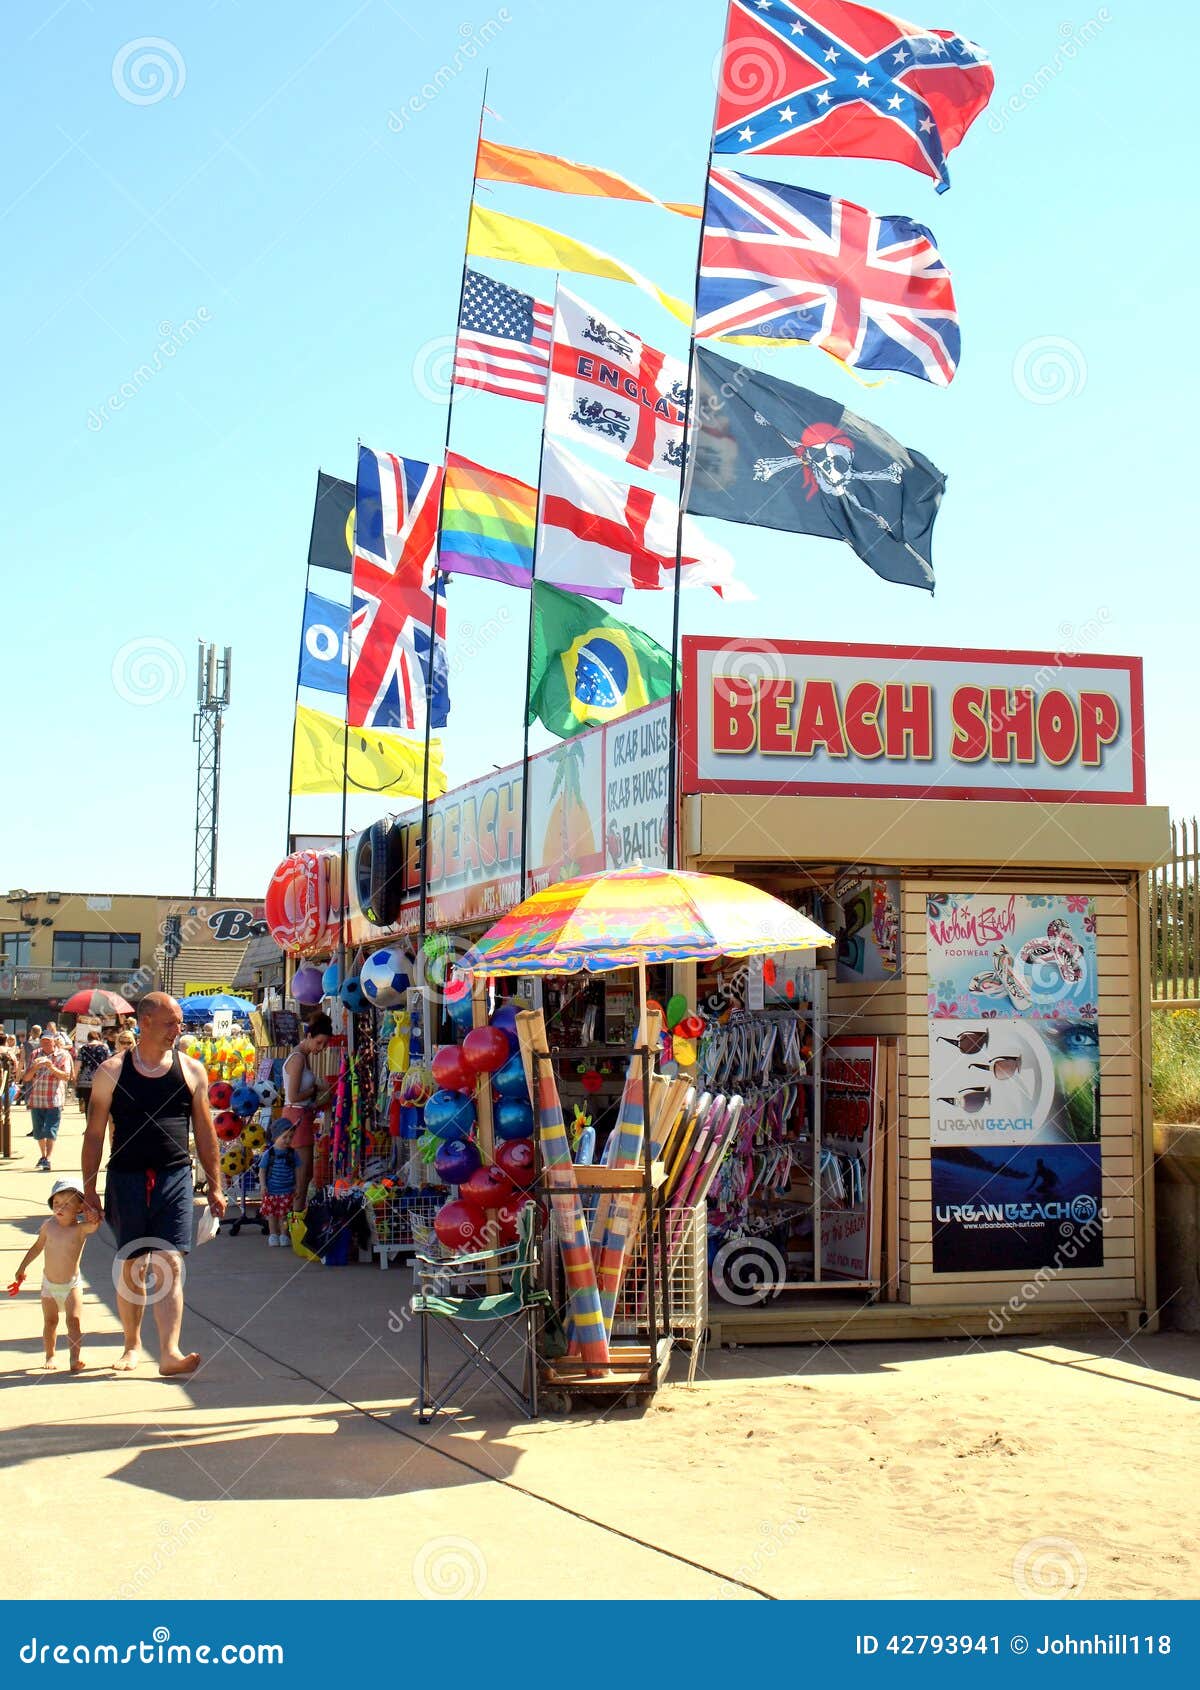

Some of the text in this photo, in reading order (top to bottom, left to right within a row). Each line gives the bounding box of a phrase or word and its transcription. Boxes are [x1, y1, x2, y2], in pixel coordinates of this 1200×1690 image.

[613, 716, 668, 768] CRAB LINES
[712, 674, 1121, 766] BEACH SHOP
[607, 776, 631, 813] CRAB
[427, 776, 522, 884] BEACH
[622, 816, 659, 864] BAIT!
[944, 949, 990, 957] FOOTWEAR
[963, 1221, 1045, 1230] www.urbanbeach-surf.com
